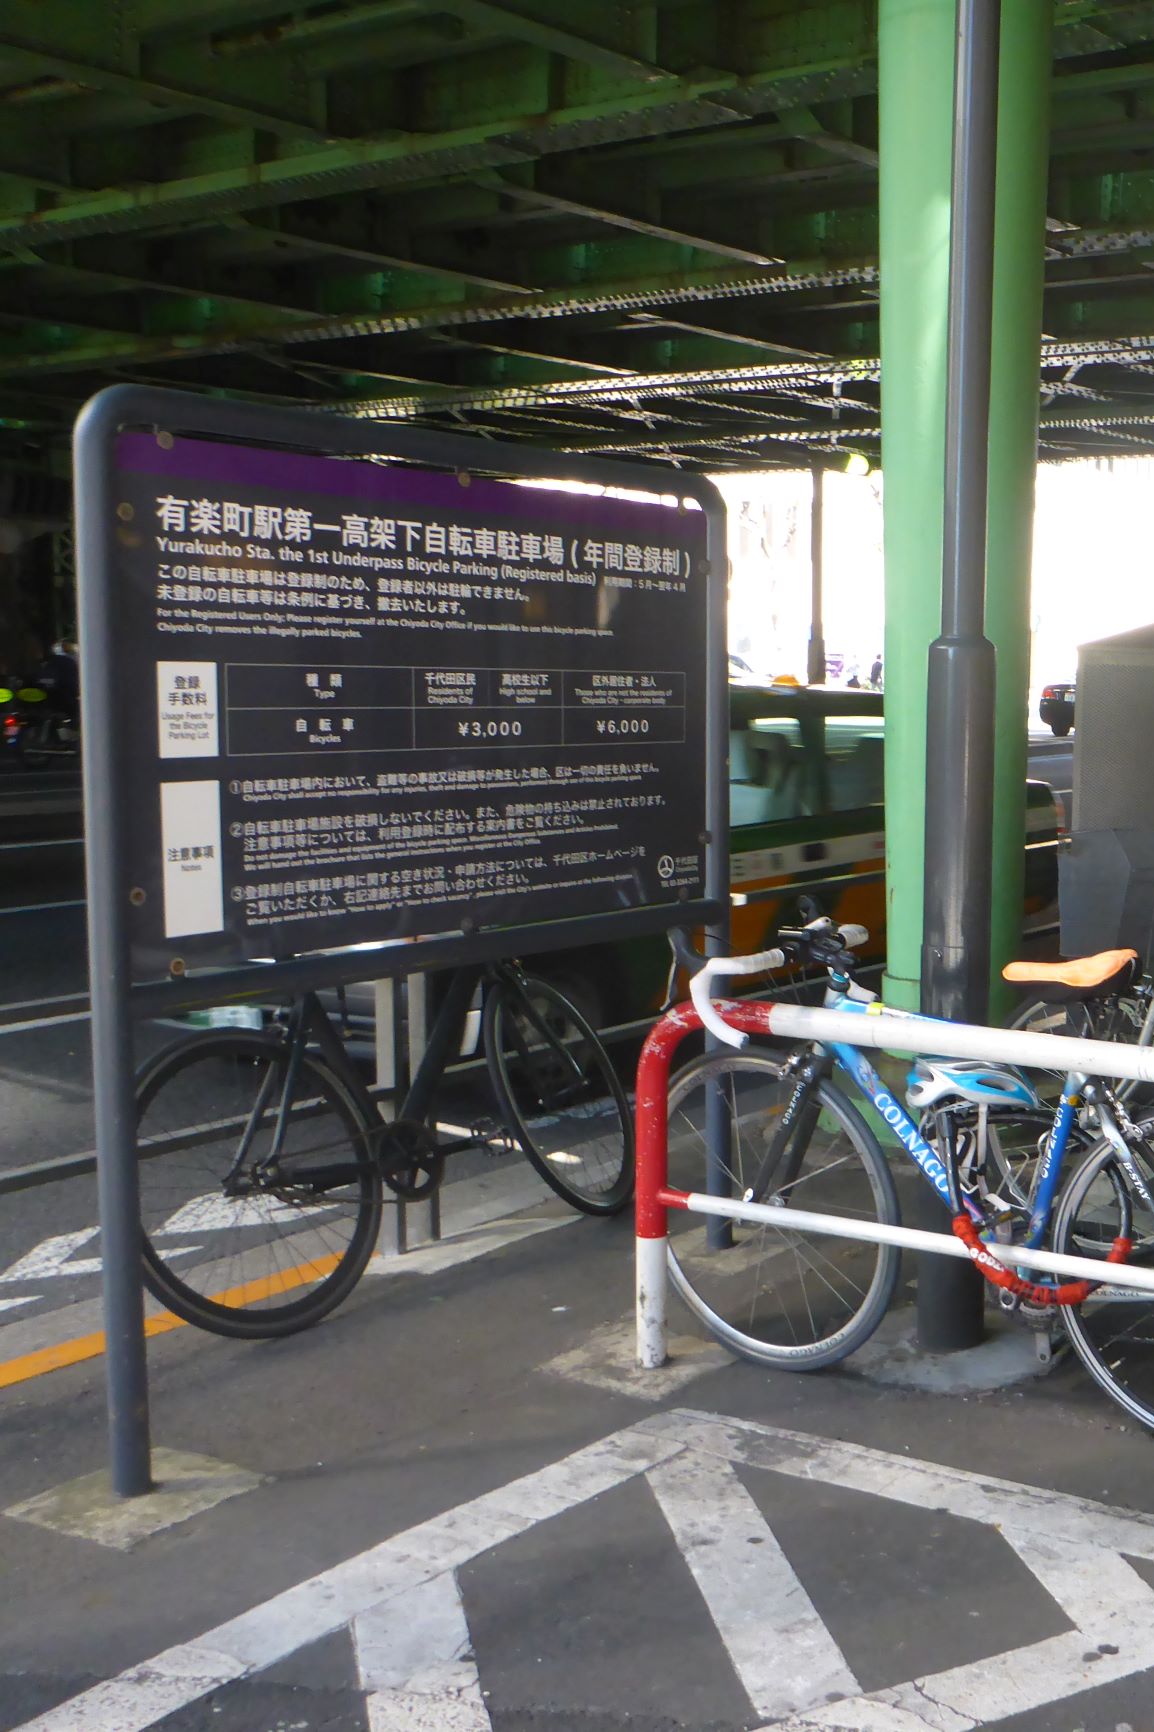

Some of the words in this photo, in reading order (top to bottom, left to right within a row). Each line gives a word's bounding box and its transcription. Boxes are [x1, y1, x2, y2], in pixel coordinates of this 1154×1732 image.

[156, 536, 243, 557] Yurakucho
[246, 544, 275, 560] Sta.
[280, 547, 303, 562] the
[308, 549, 329, 564] 1st
[332, 551, 403, 572] Underpass
[406, 557, 450, 576] Bicycle
[453, 561, 498, 580] Parking
[501, 565, 563, 584] (Registered
[567, 571, 597, 584] basis)
[174, 675, 200, 690] 登録
[168, 692, 207, 706] 手数料
[314, 689, 335, 699] Type
[459, 696, 474, 705] City
[458, 721, 522, 738] ¥3,000
[596, 720, 649, 735] ¥6,000
[169, 731, 196, 740] Parking
[309, 734, 341, 744] Bicycles
[874, 1092, 950, 1193] COLNAGO
[1122, 1162, 1151, 1200] B-STAY
